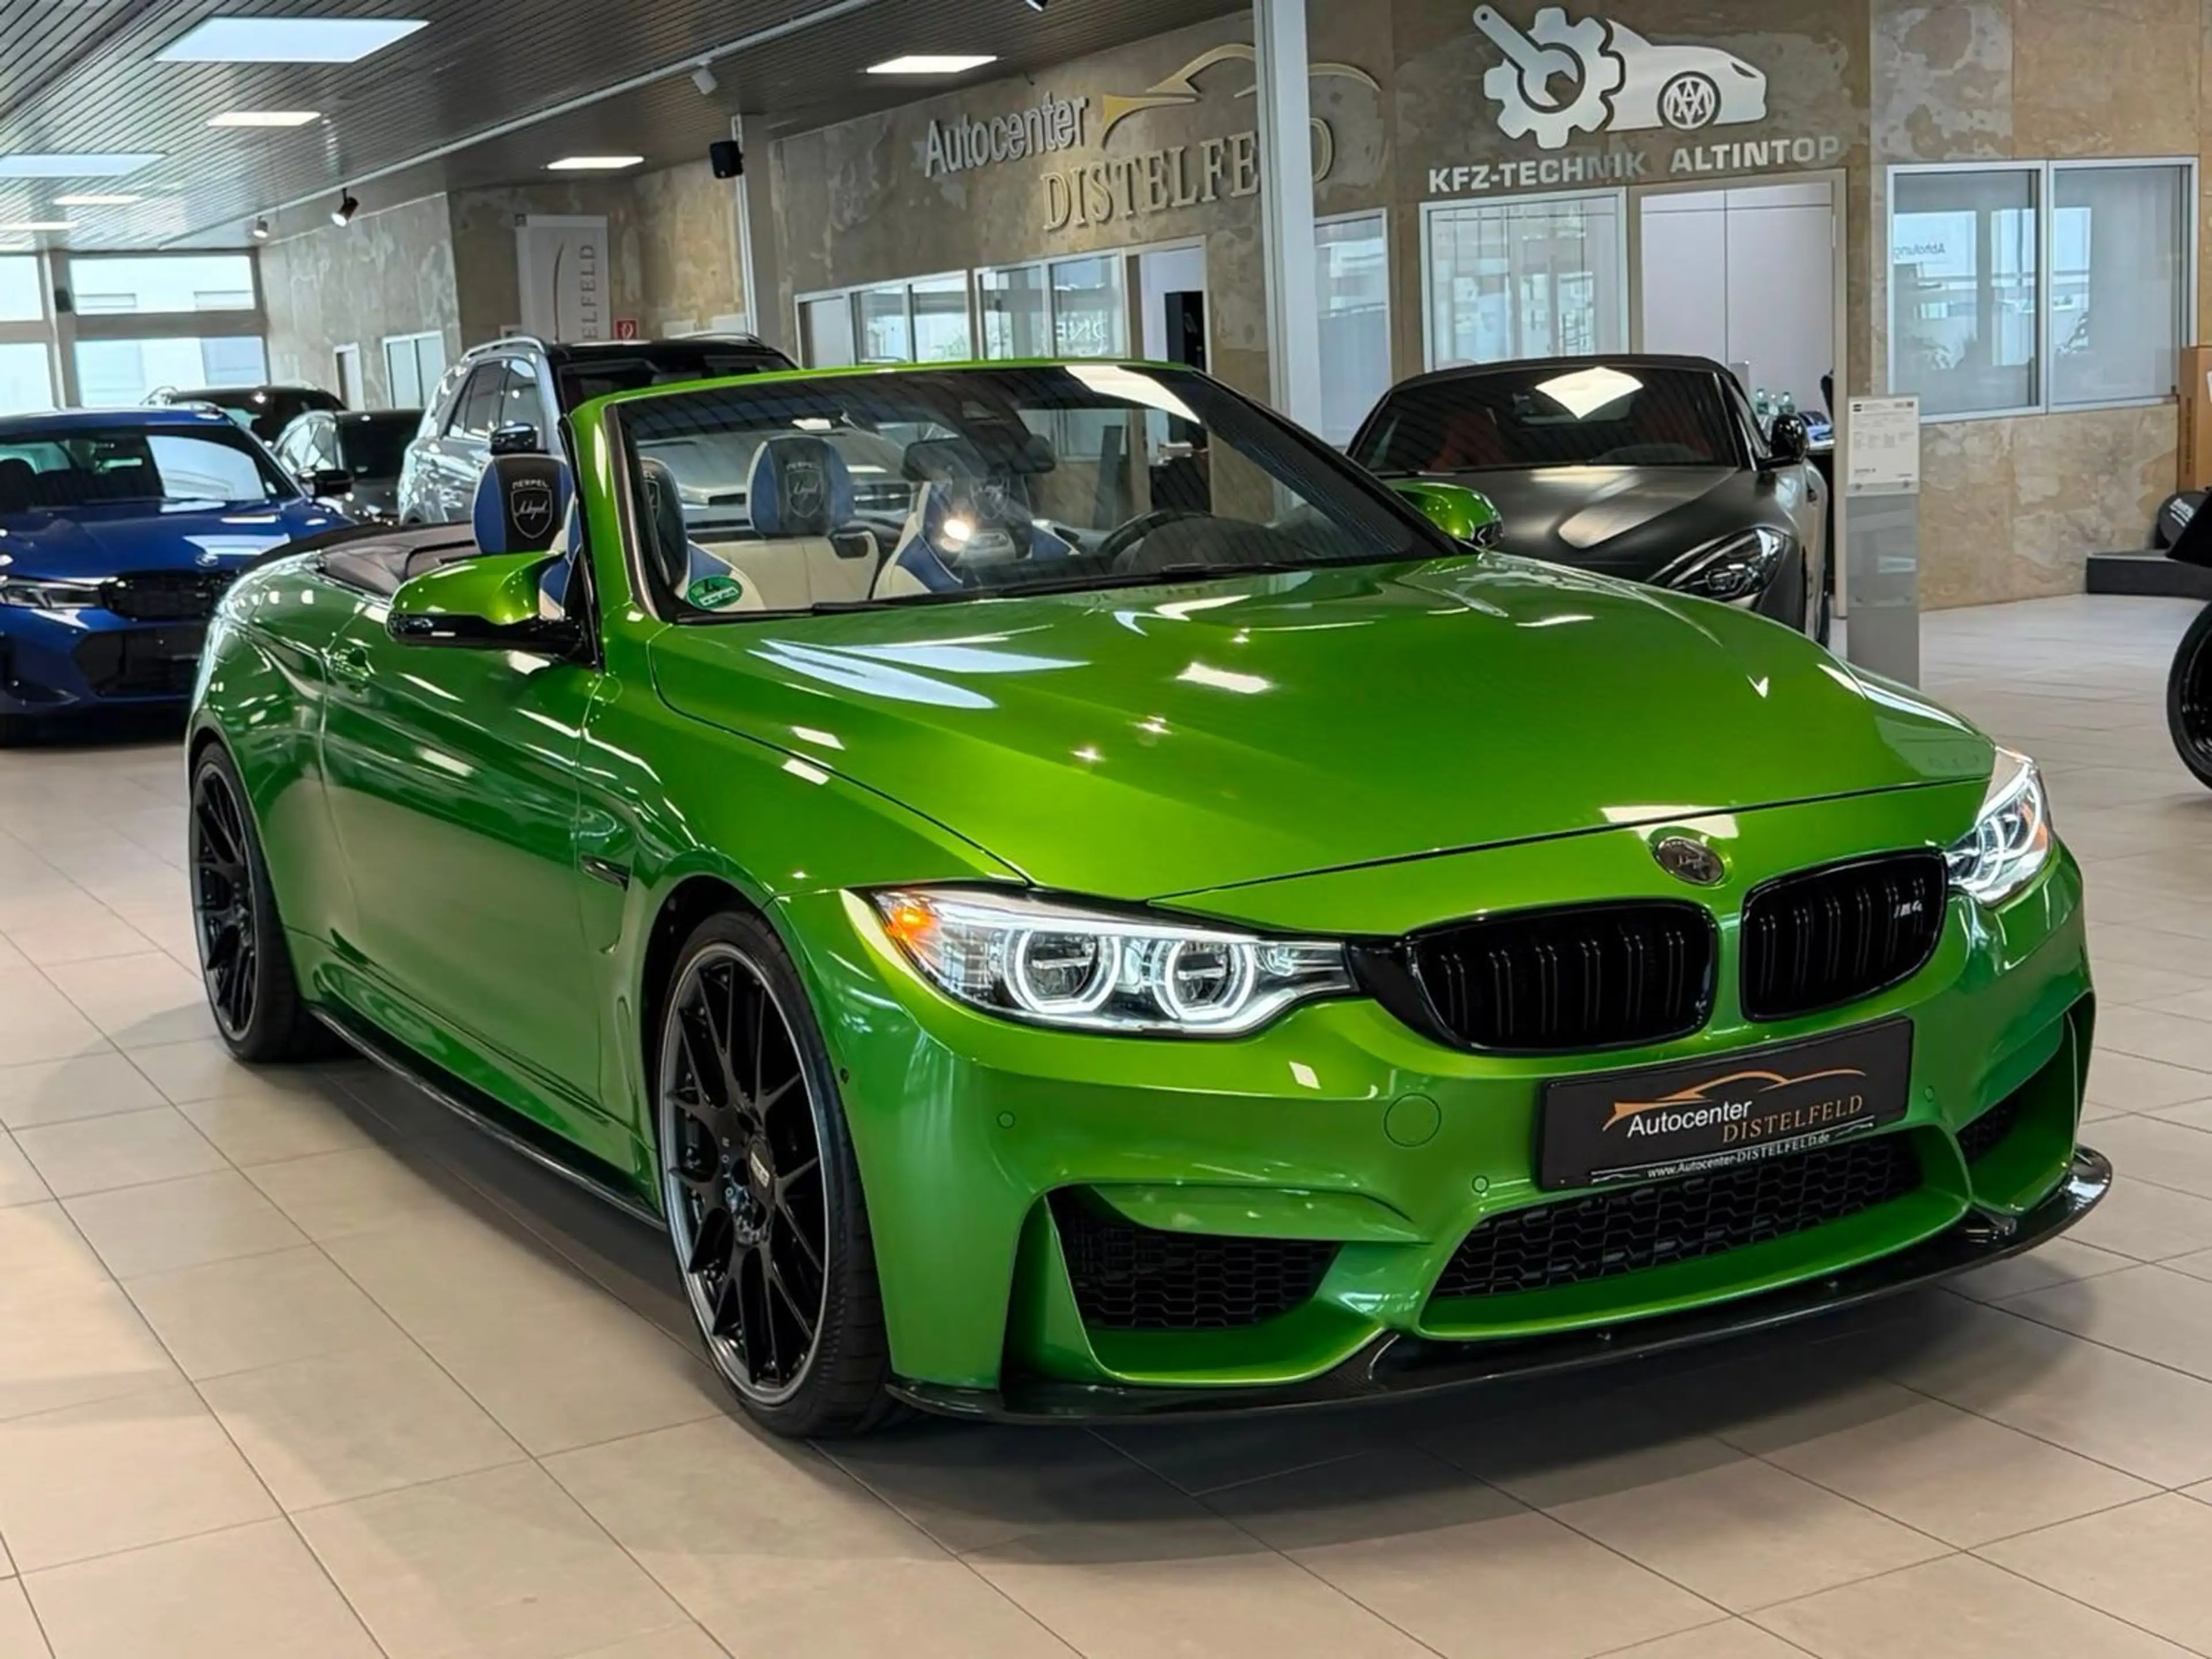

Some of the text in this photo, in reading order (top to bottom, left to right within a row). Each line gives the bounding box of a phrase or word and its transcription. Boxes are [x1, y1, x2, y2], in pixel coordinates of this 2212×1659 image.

[924, 90, 1087, 178] Autocenter
[1040, 117, 1332, 230] DISTELFED
[1429, 136, 1839, 194] KFZ-TECHNIK ALTINTOP
[1900, 900, 1923, 917] M4
[1627, 1100, 1753, 1138] Autocenter
[1722, 1094, 1863, 1143] DISTELFELD
[1647, 1133, 1830, 1179] www.Autocenter-DISTELFELD.de
